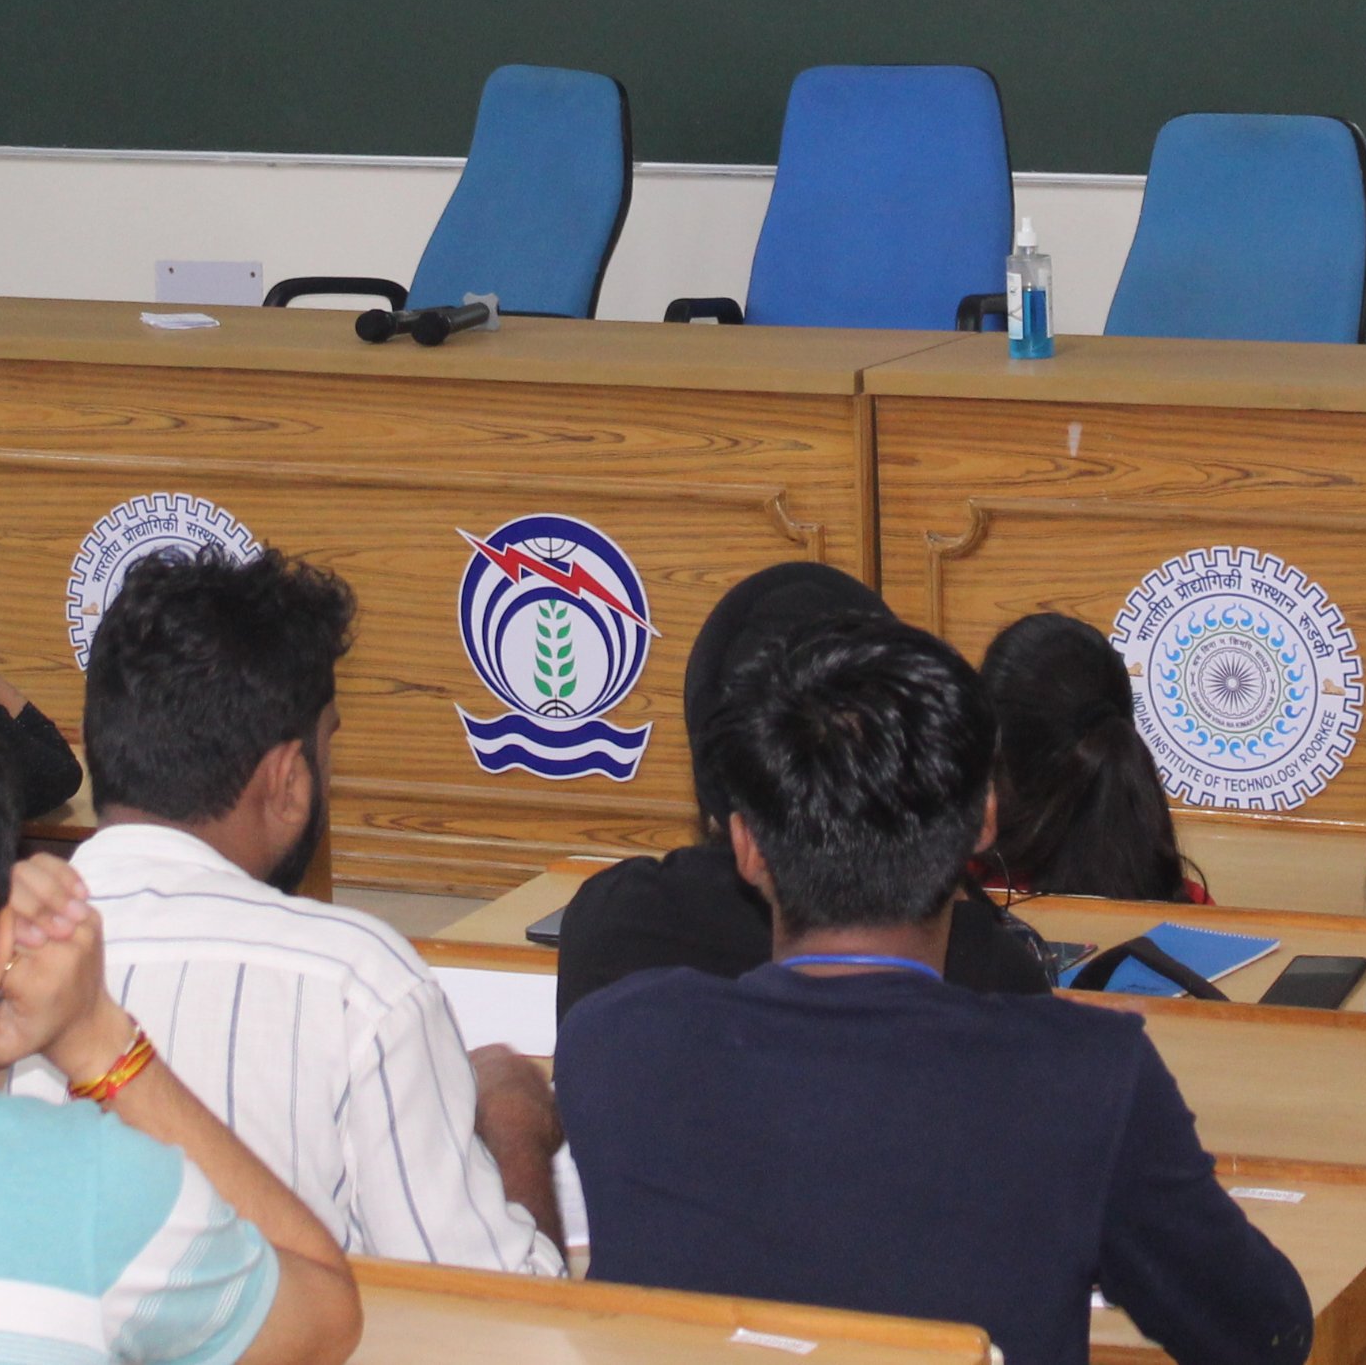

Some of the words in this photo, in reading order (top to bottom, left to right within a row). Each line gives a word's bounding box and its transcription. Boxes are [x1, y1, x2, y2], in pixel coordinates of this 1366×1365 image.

[92, 539, 123, 583] भारतीय
[1137, 595, 1175, 643] भारतीय
[1174, 569, 1242, 602] प्रौद्योगिकी
[1250, 575, 1298, 614] संस्थान
[1132, 692, 1156, 736] INDIAN
[1149, 734, 1202, 782] INSTITUTE
[1205, 772, 1220, 788] OF
[1224, 762, 1301, 792] TECHNOLOGY
[1299, 709, 1336, 766] ROORKEE
